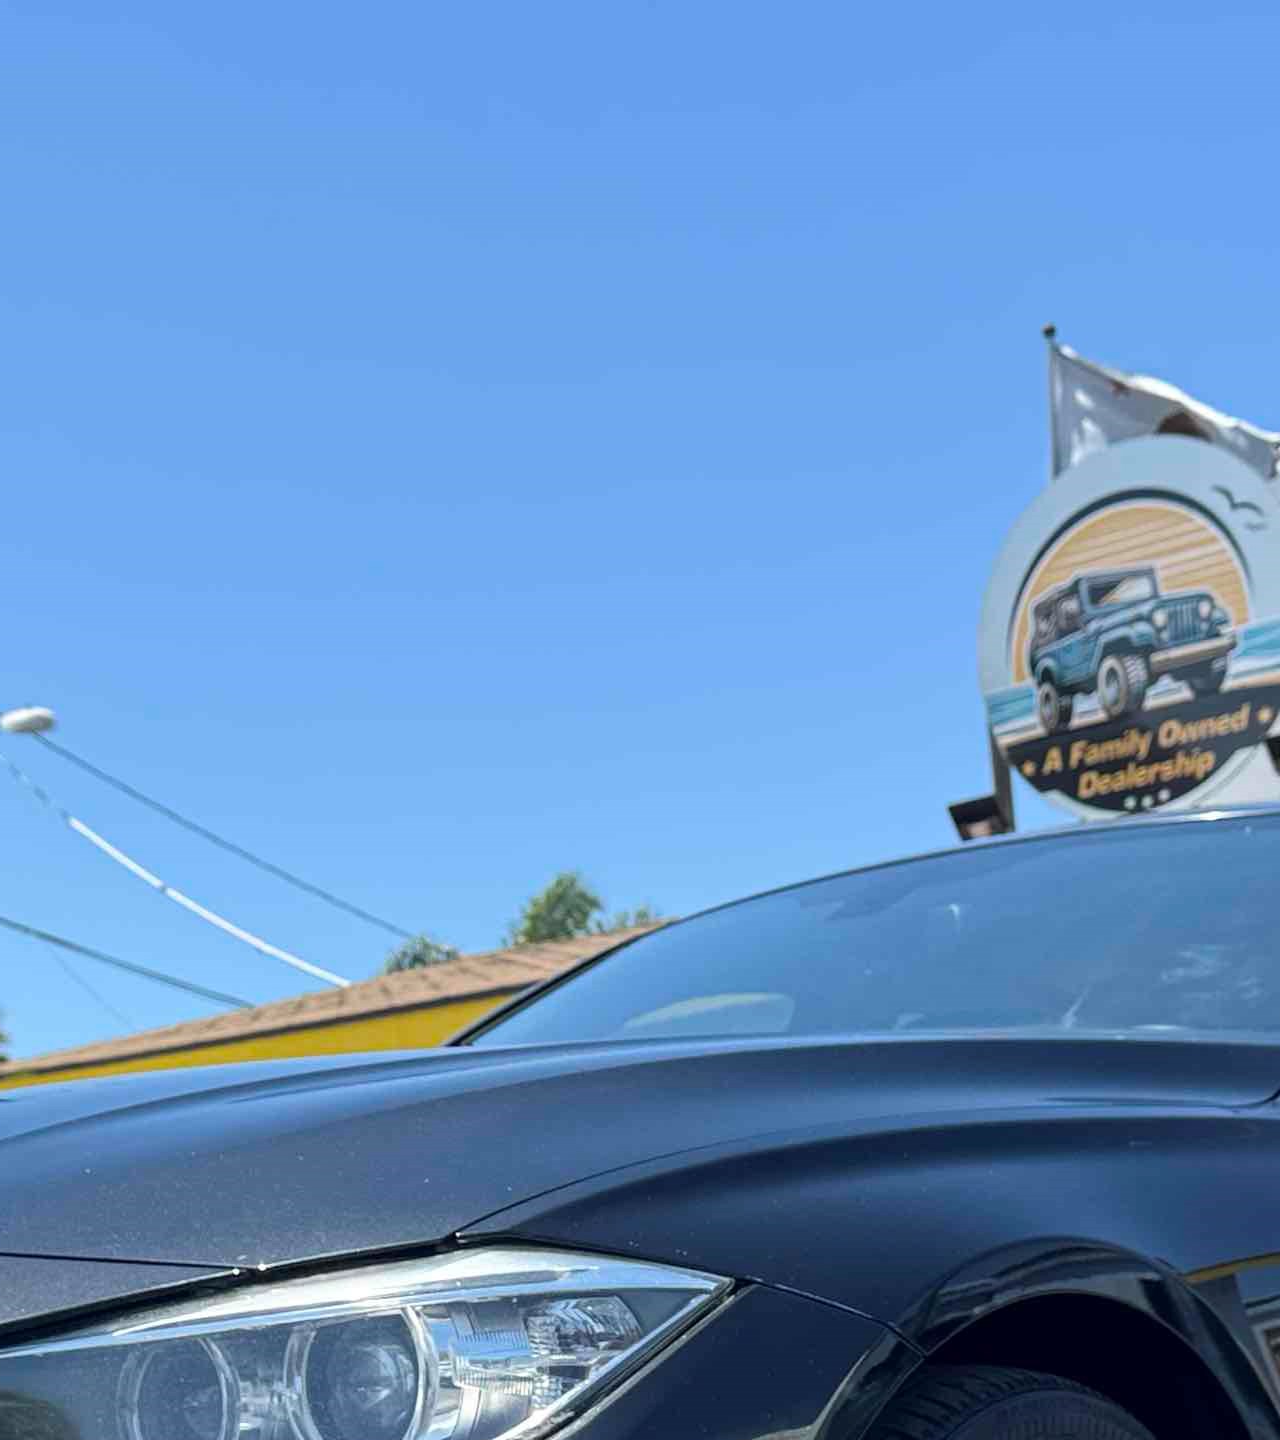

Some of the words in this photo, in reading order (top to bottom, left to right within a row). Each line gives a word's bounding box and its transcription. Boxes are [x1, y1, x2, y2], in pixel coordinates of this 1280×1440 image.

[1040, 746, 1063, 776] A
[1070, 726, 1153, 769] Family
[1157, 703, 1252, 749] Owned
[1077, 747, 1216, 799] Dealership
